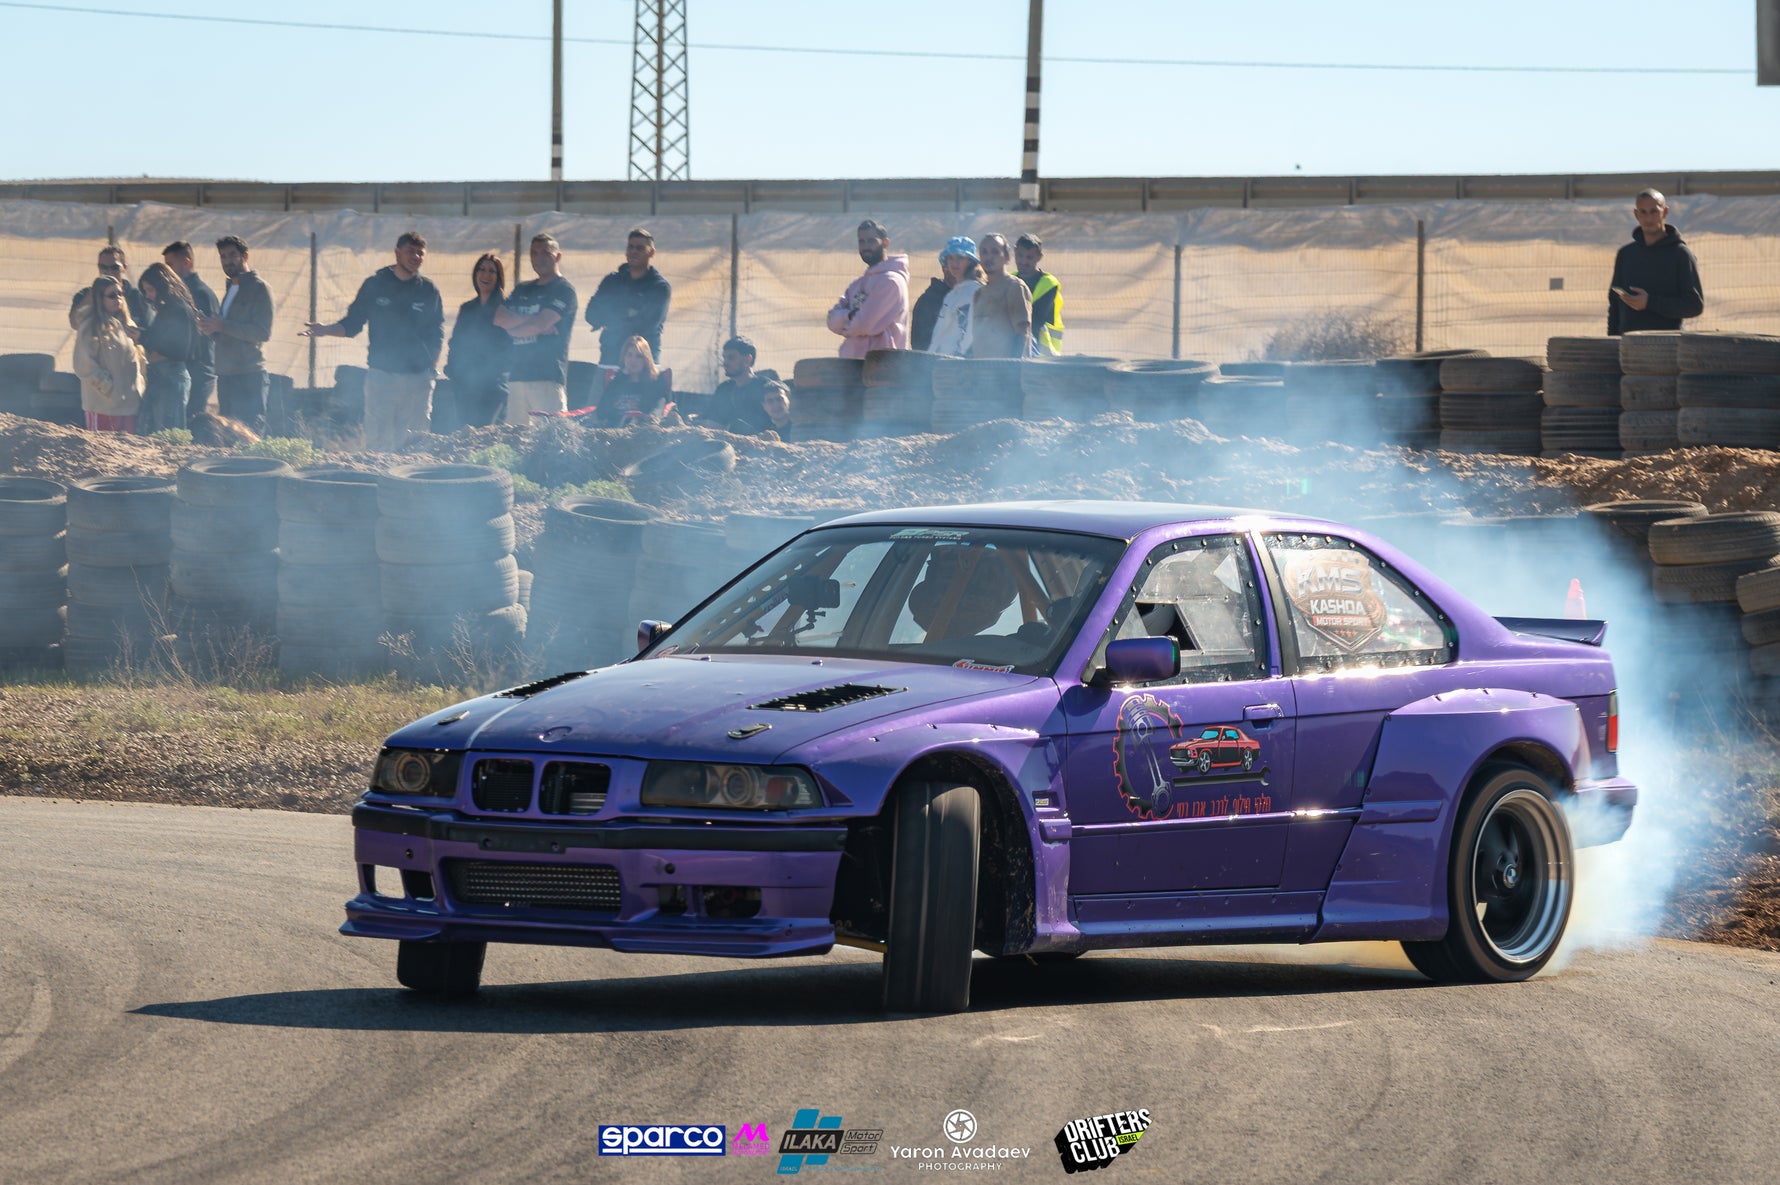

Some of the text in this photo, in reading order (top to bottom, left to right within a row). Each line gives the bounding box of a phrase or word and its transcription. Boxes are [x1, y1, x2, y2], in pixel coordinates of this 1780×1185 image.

[1297, 566, 1362, 598] KMS
[1316, 617, 1369, 626] MOTOR SPORT
